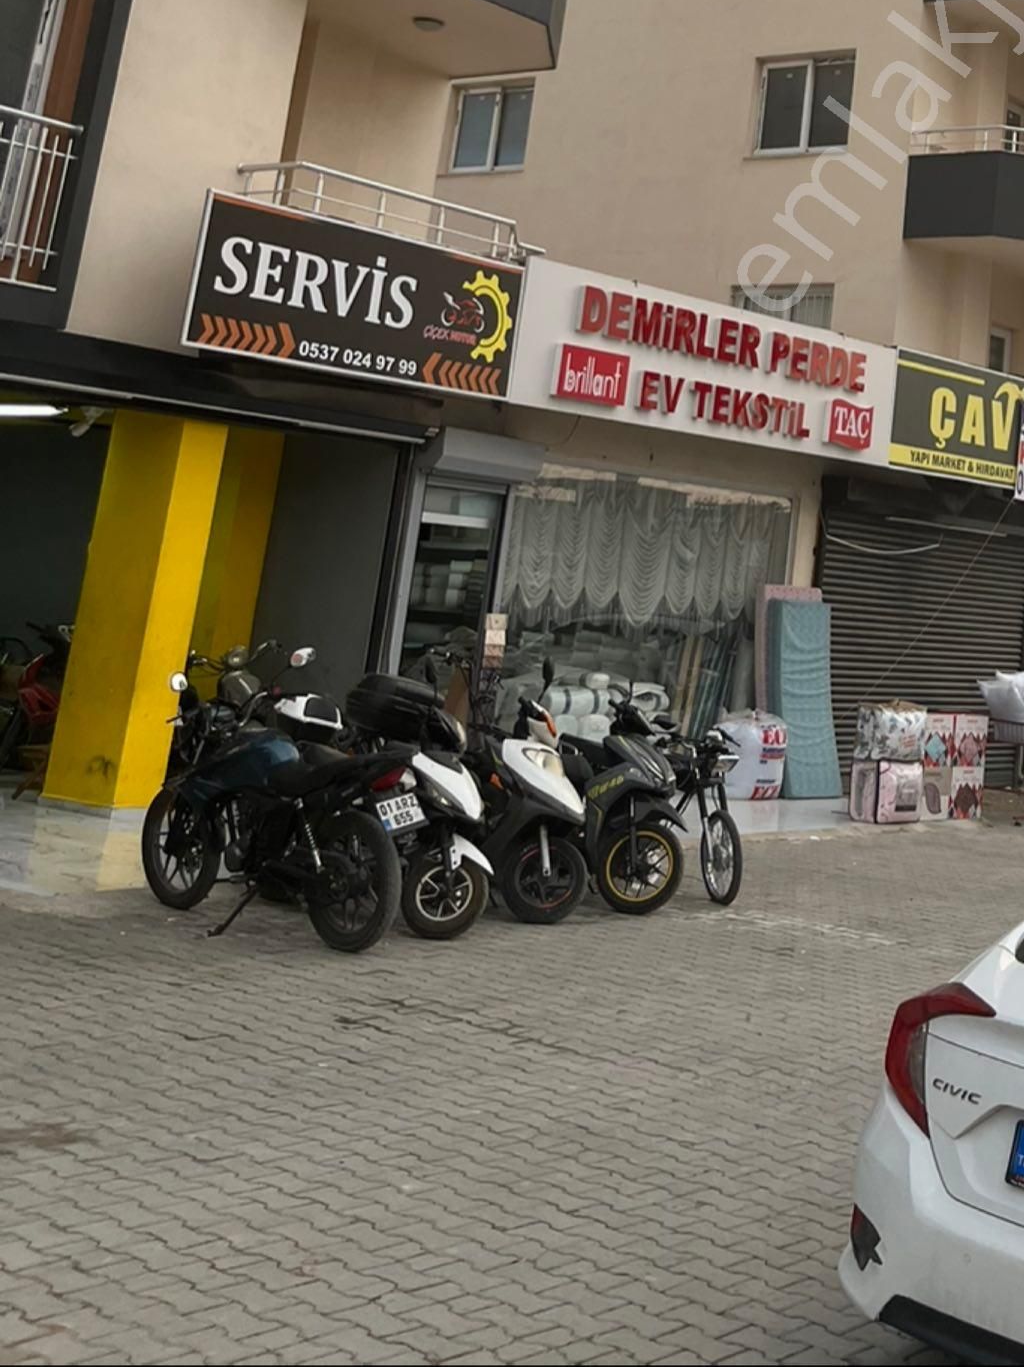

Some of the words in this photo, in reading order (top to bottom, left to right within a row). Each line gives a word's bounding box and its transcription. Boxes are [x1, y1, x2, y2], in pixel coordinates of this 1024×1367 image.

[213, 236, 418, 330] SERVİS
[299, 340, 339, 362] 0537
[343, 349, 372, 368] 024
[376, 355, 395, 372] 97
[399, 359, 417, 376] 99
[563, 352, 623, 400] brillant
[768, 331, 867, 393] PERDE
[639, 371, 684, 413] EV
[834, 406, 871, 445] TAÇ
[911, 450, 930, 465] YAPI
[931, 454, 966, 471] MARKET
[967, 461, 974, 473] &
[975, 462, 1014, 480] HIRDAVAT
[379, 802, 393, 816] 01
[932, 1077, 982, 1105] CIVIC
